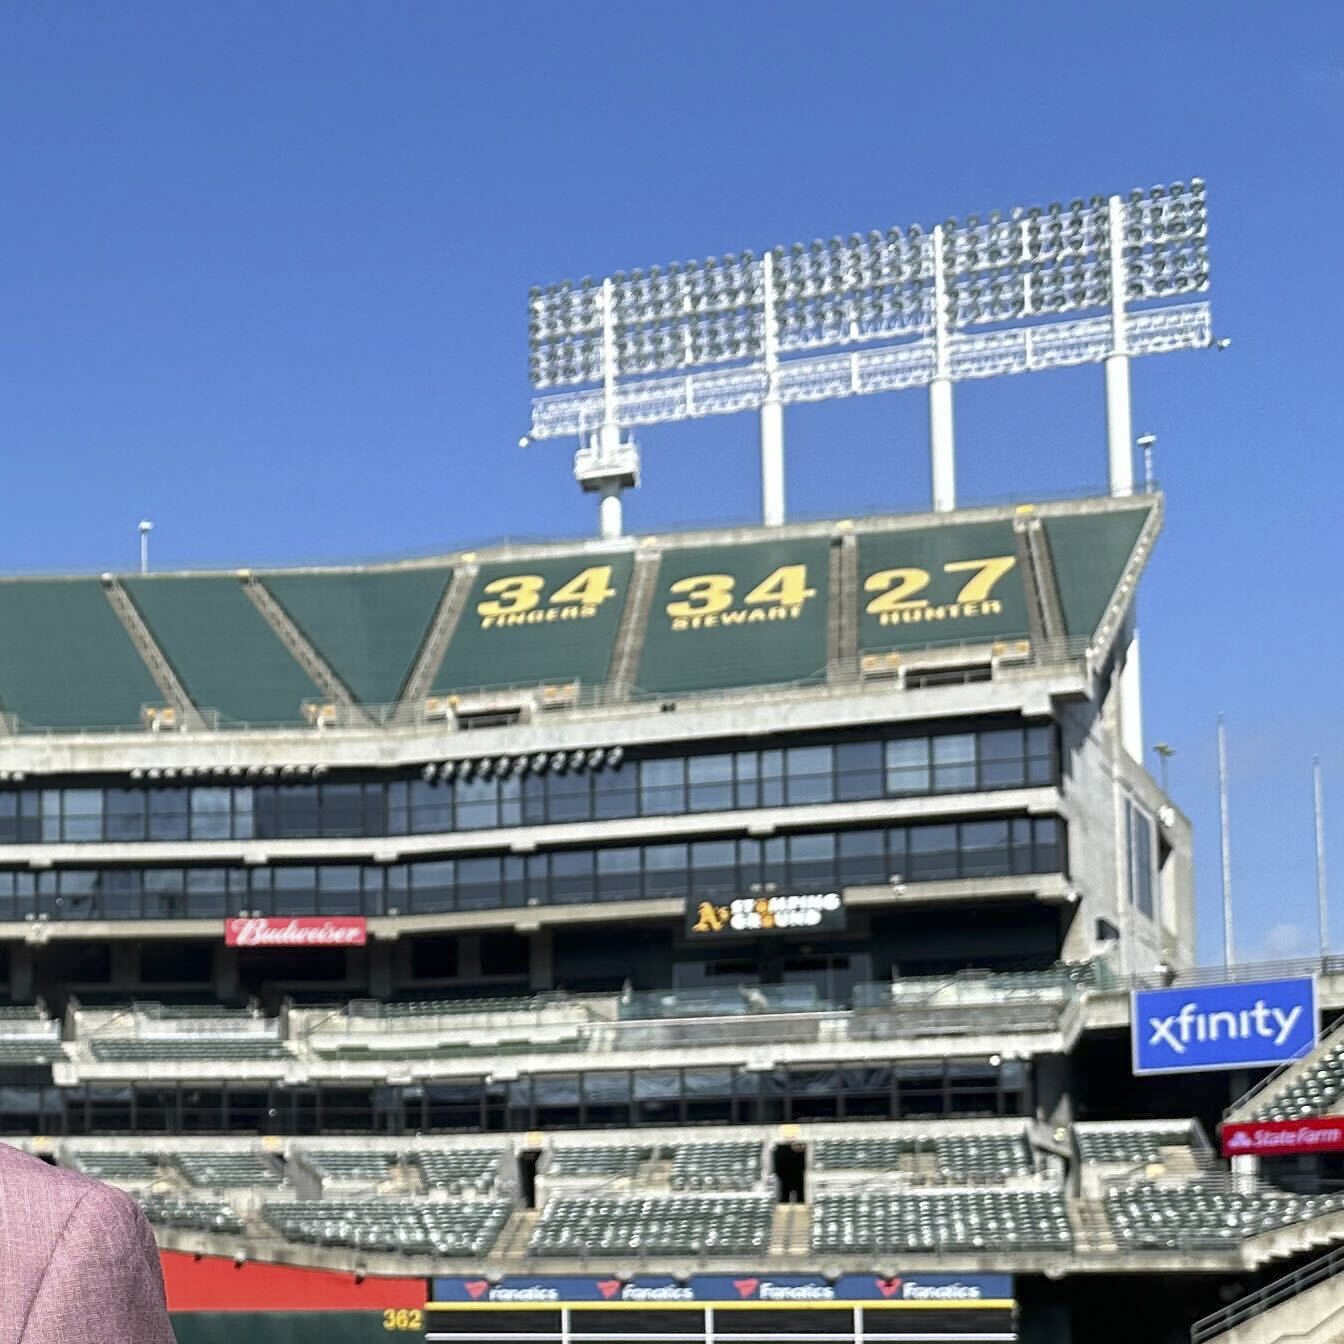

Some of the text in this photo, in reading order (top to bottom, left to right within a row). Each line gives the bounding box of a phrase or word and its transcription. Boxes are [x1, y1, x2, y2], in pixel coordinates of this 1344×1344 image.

[477, 564, 616, 617] 34
[666, 563, 817, 618] 34
[864, 555, 1017, 614] 27
[480, 603, 599, 630] FINGERS
[670, 605, 803, 631] STEWART
[878, 600, 1002, 626] HUNTER
[230, 917, 362, 945] Budweiser
[1148, 1000, 1303, 1055] xfinity
[759, 1282, 836, 1300] Fanatics
[902, 1282, 981, 1300] Fanatics
[383, 1308, 422, 1330] 362
